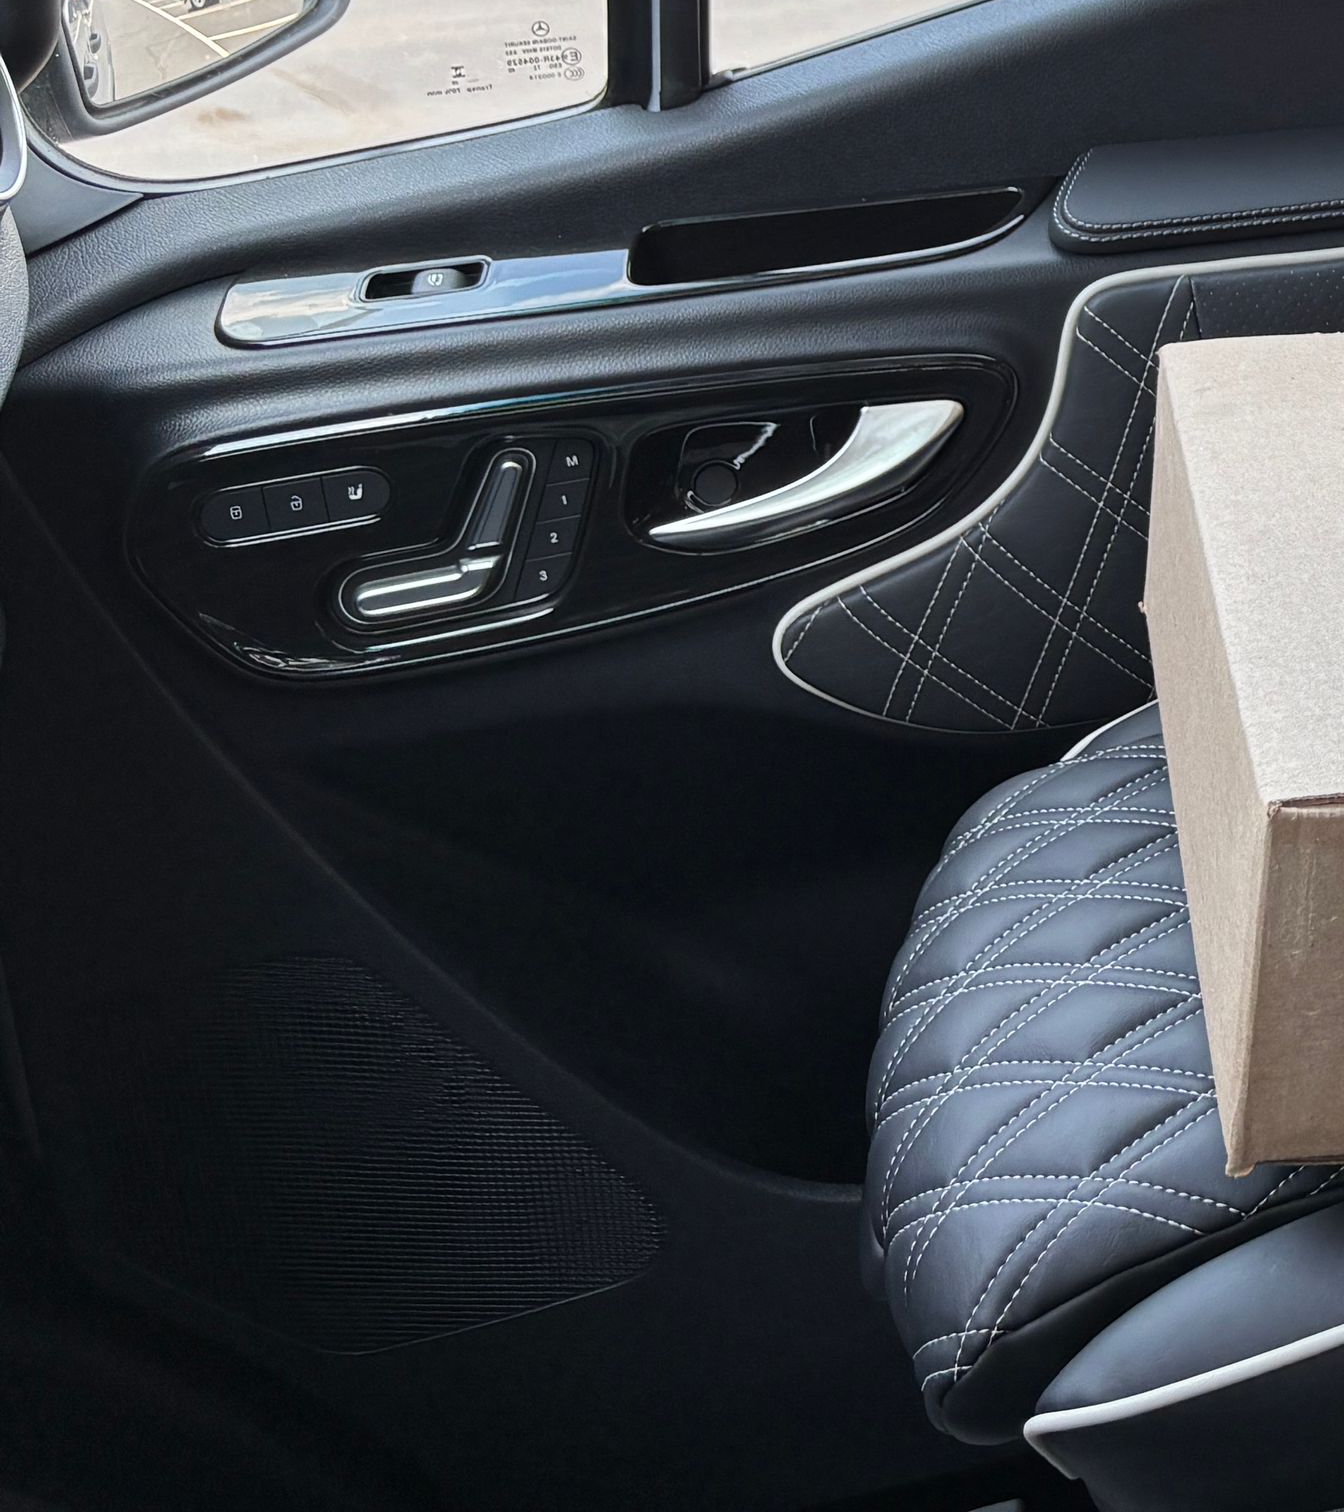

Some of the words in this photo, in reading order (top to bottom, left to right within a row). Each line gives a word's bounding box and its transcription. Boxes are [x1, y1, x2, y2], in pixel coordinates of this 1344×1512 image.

[565, 455, 579, 467] M
[561, 495, 568, 505] 1
[550, 532, 559, 543] 2
[539, 570, 548, 581] 3
